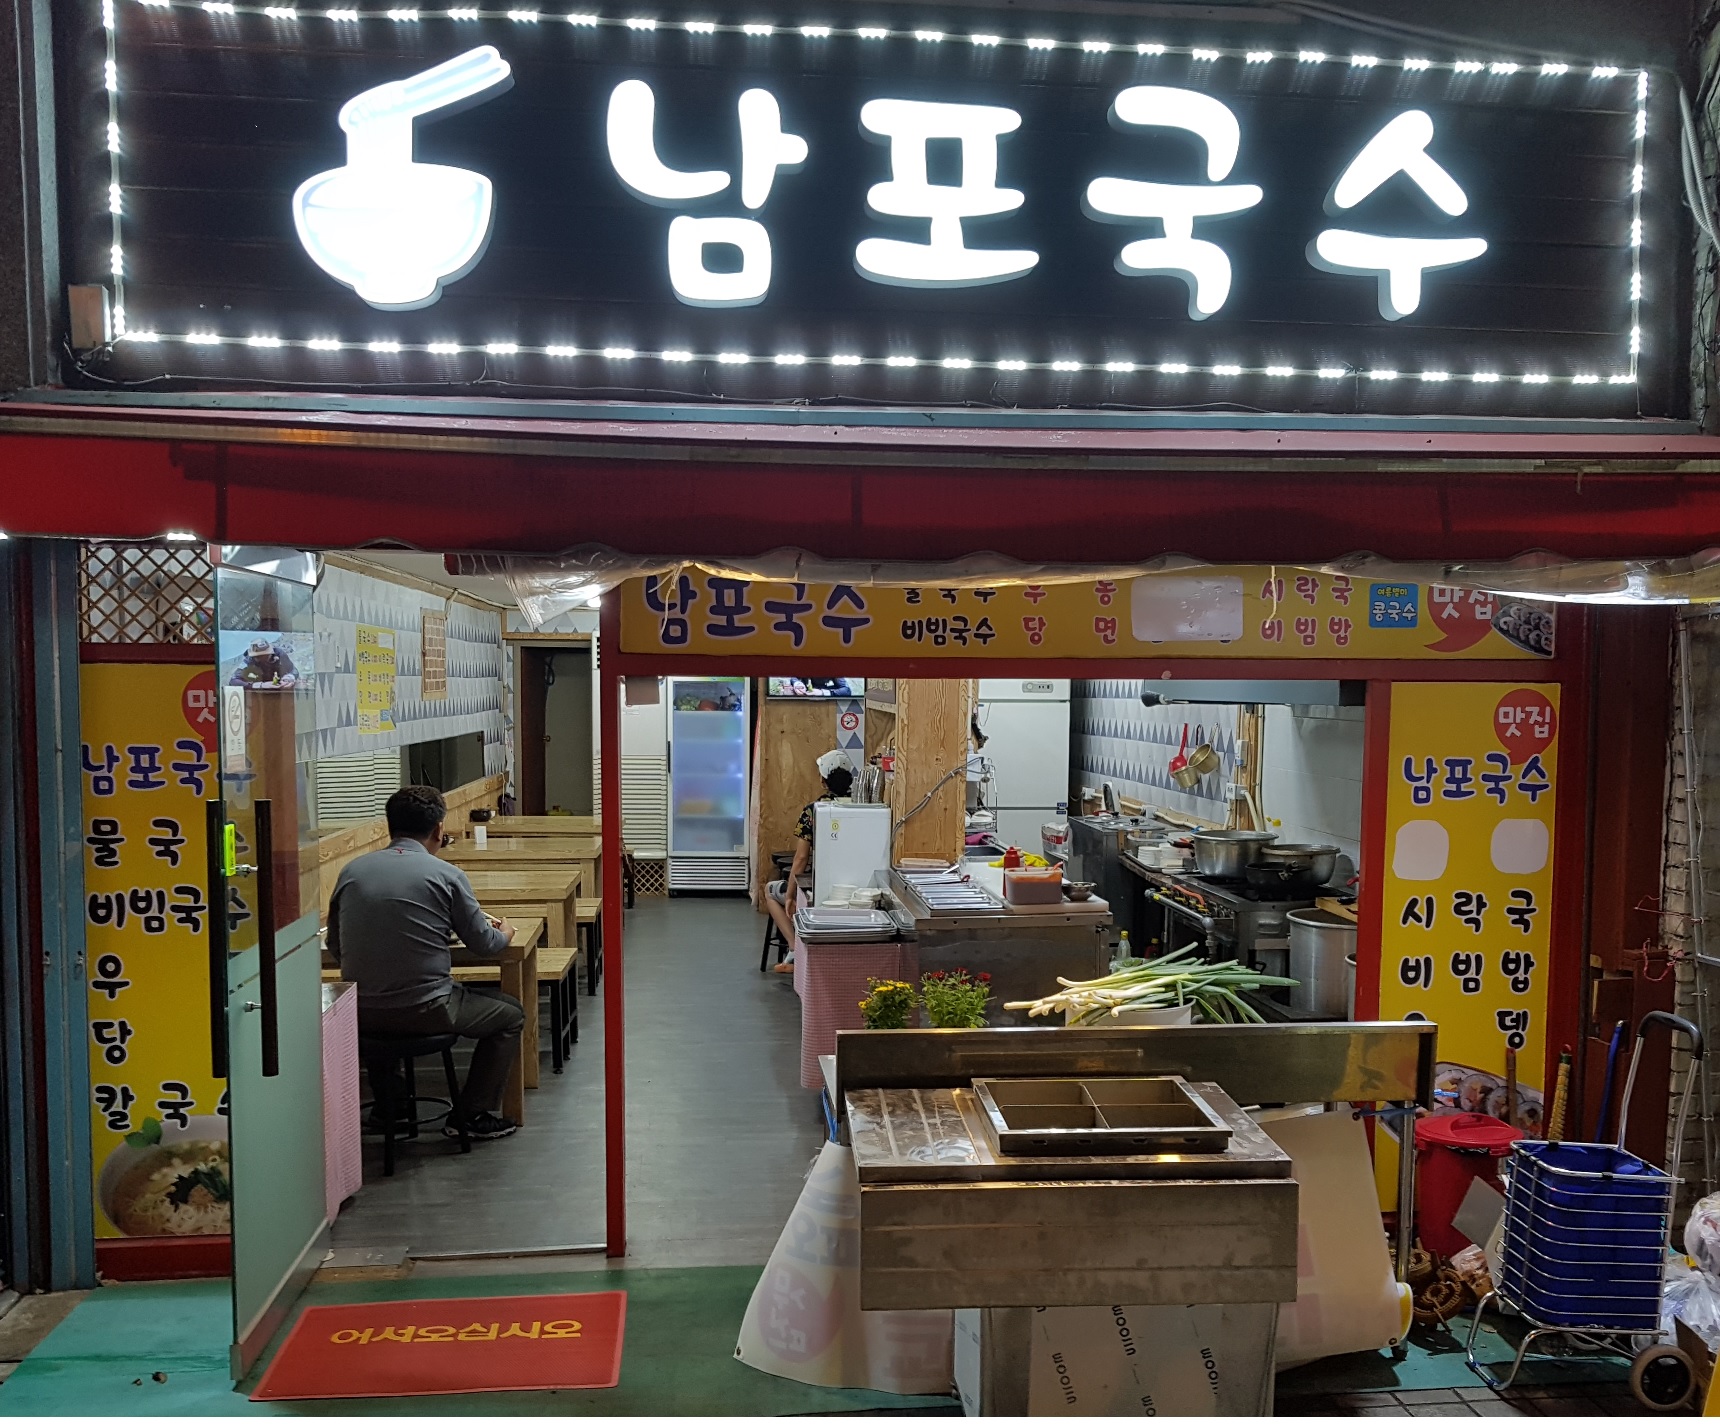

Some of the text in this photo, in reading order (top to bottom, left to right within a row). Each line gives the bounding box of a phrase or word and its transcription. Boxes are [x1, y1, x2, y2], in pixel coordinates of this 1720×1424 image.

[605, 78, 1489, 318] 남포국수
[646, 573, 871, 647] 남포국수
[1372, 601, 1417, 621] 콩국수
[901, 616, 996, 646] 비빔국수
[1498, 706, 1551, 738] 맛집
[1403, 753, 1550, 805] 남포국수
[94, 1082, 229, 1131] 칼국
[330, 1318, 583, 1345] 어서오십시오
